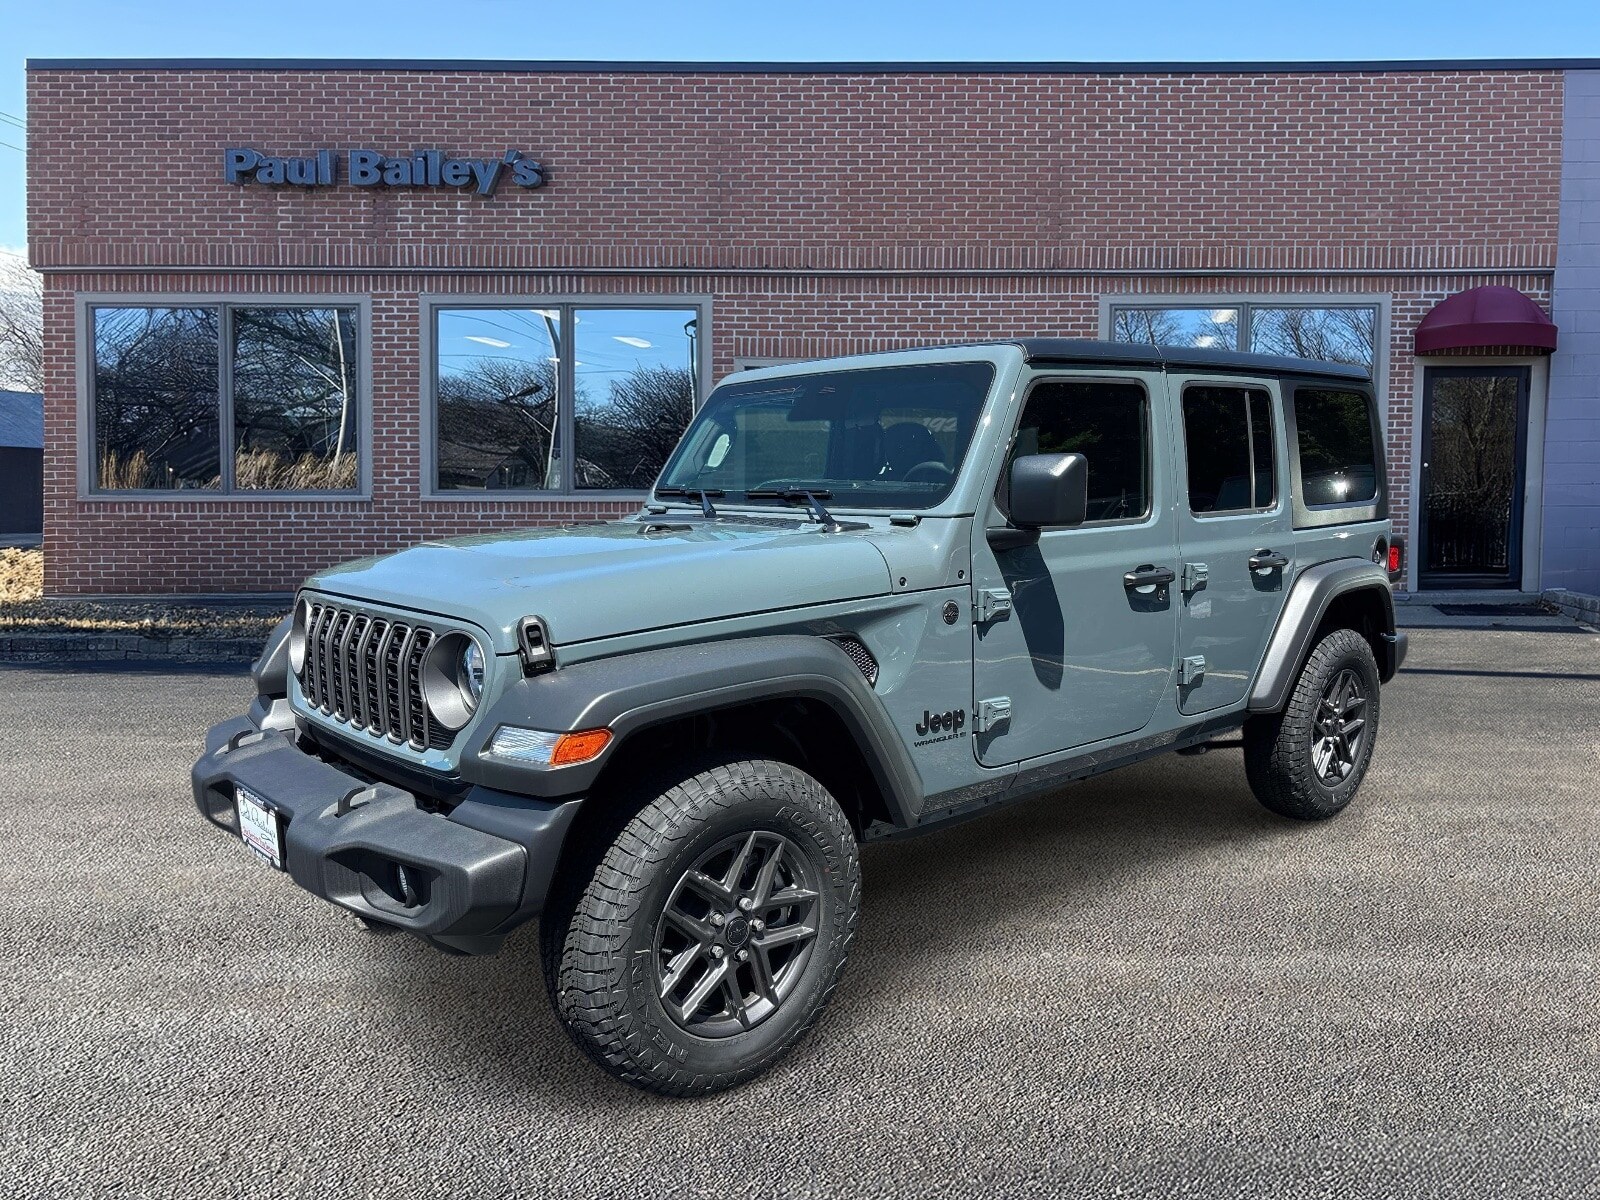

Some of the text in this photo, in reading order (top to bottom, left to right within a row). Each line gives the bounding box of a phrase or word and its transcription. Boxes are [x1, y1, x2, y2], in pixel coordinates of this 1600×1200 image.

[224, 149, 544, 196] Paul Bailey's
[913, 733, 959, 748] WRANGLER
[915, 709, 965, 737] Jeep
[775, 806, 845, 888] ROADIAN
[631, 955, 689, 1065] NEXEN
